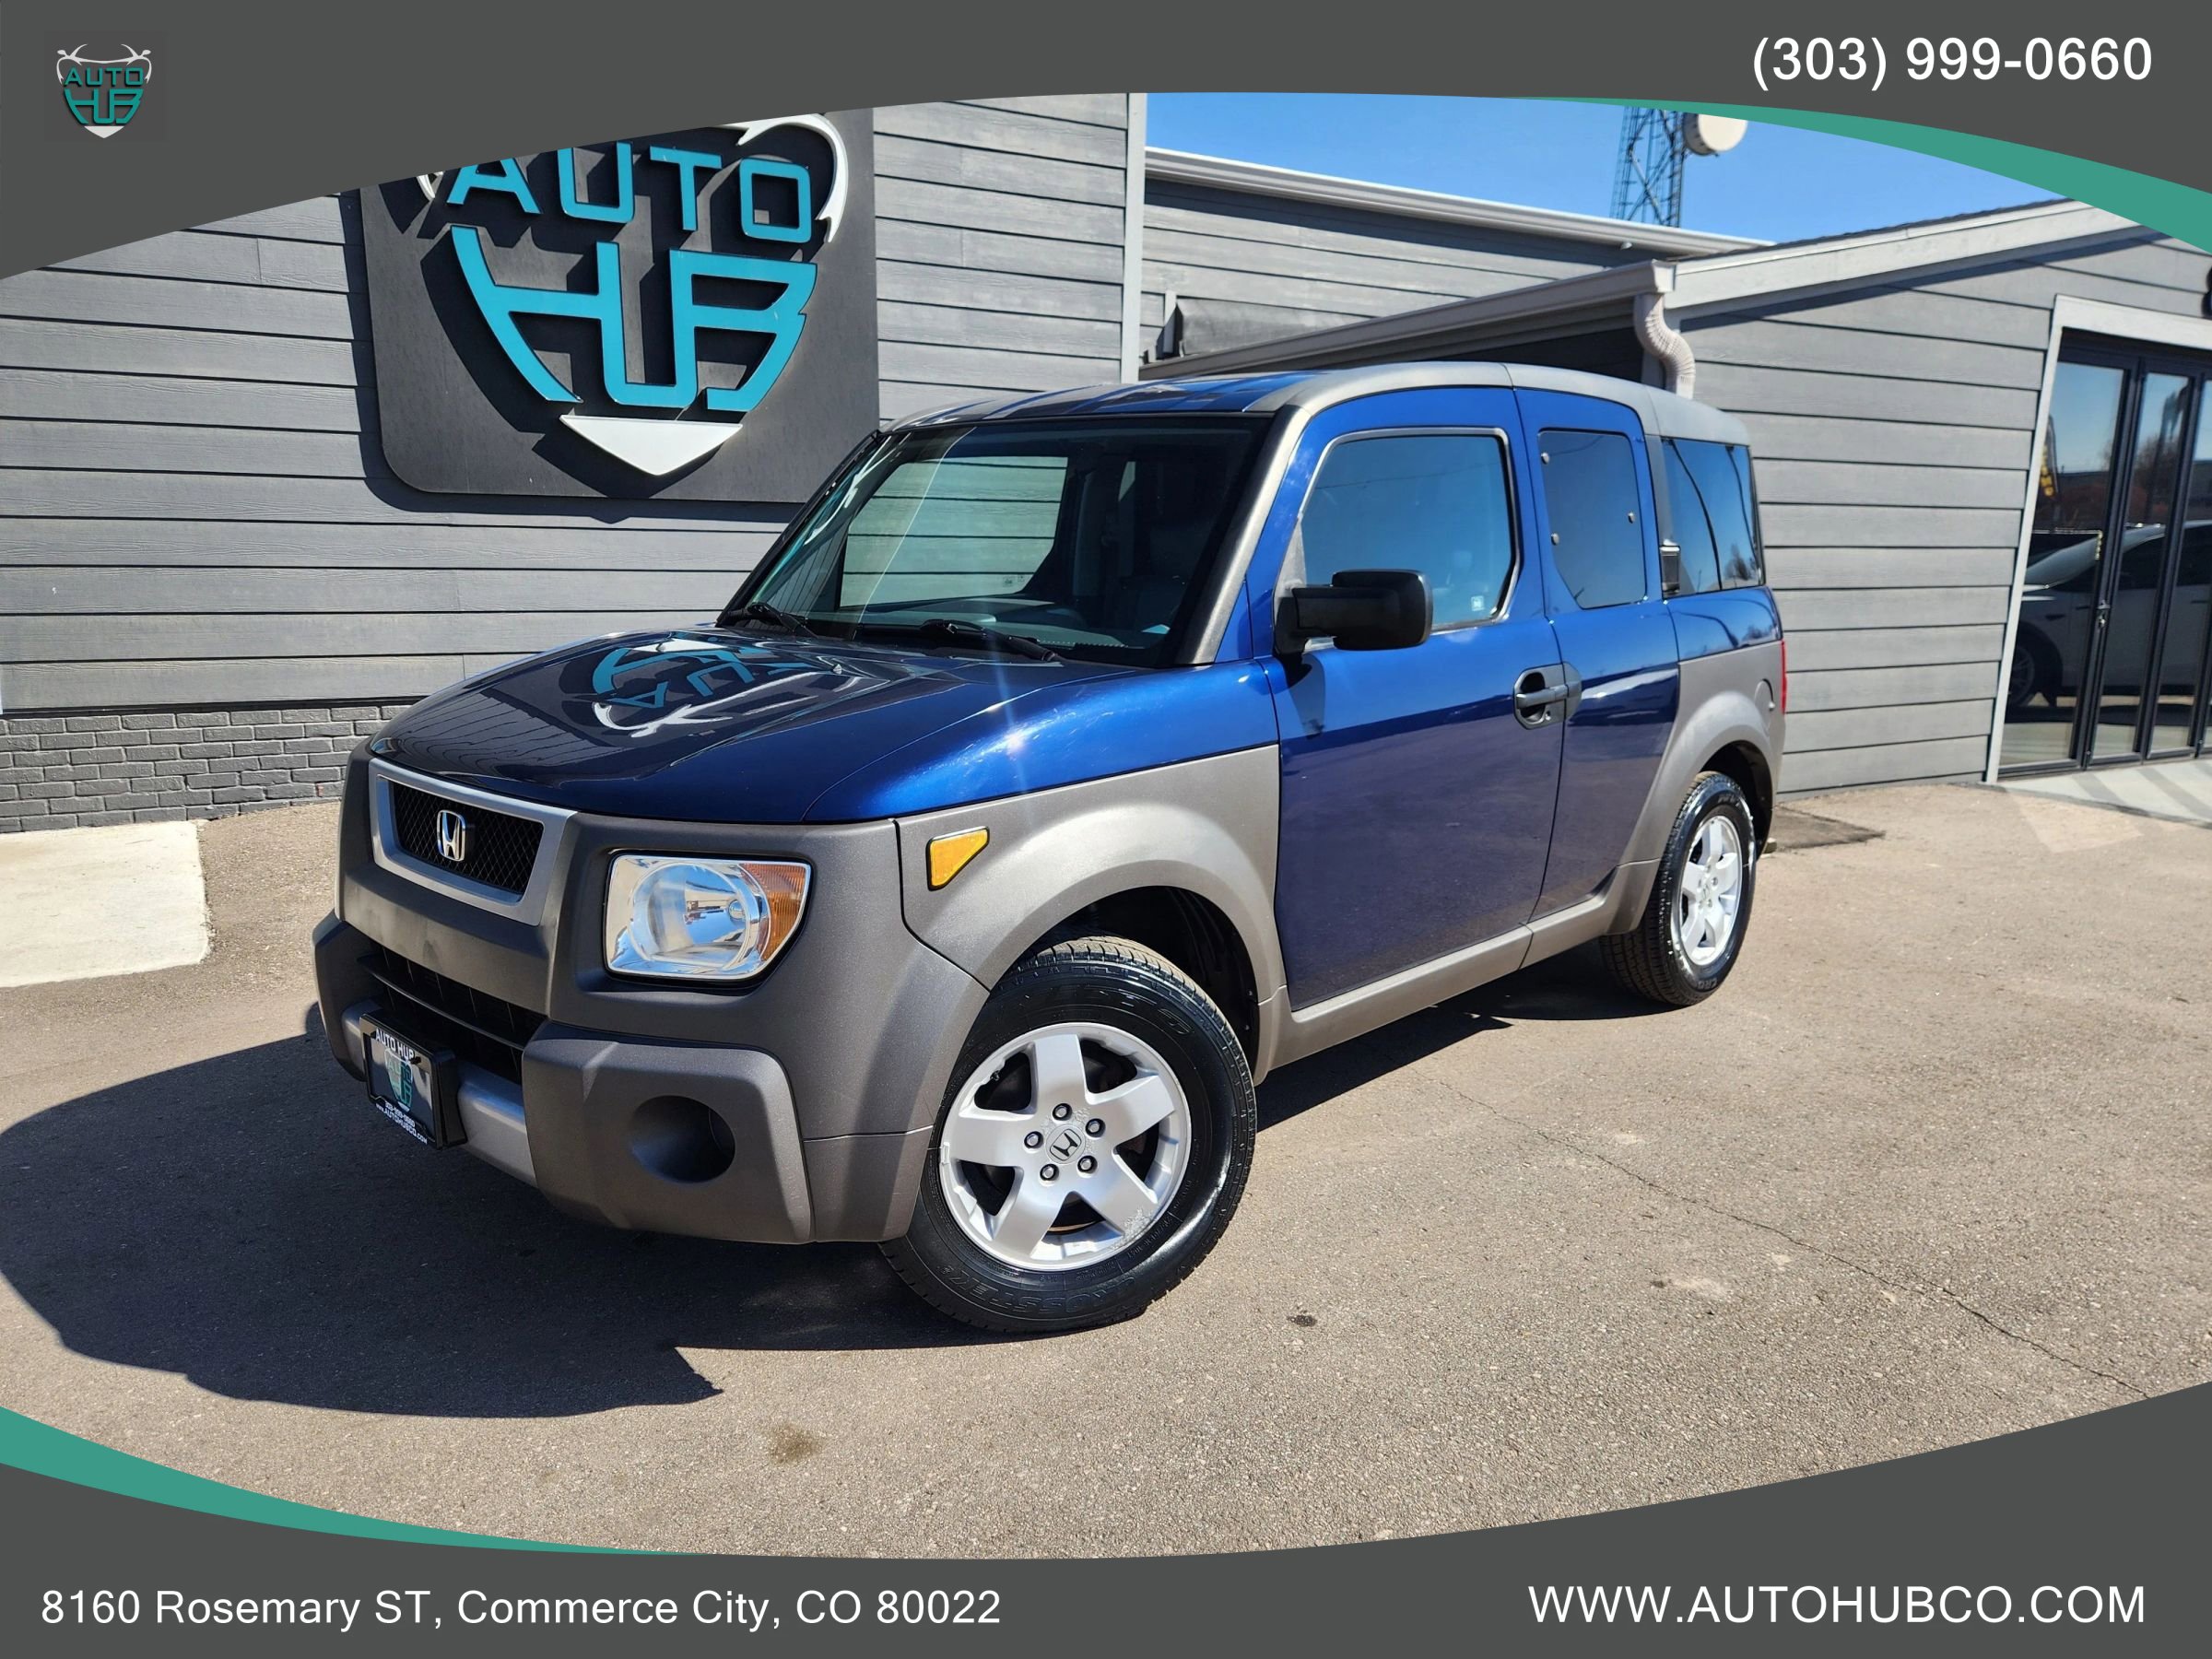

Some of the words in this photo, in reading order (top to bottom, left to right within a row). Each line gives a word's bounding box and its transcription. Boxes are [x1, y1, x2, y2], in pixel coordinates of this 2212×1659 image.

[447, 142, 812, 243] AUTO
[452, 226, 818, 412] HUB
[375, 1028, 396, 1052] AUTO
